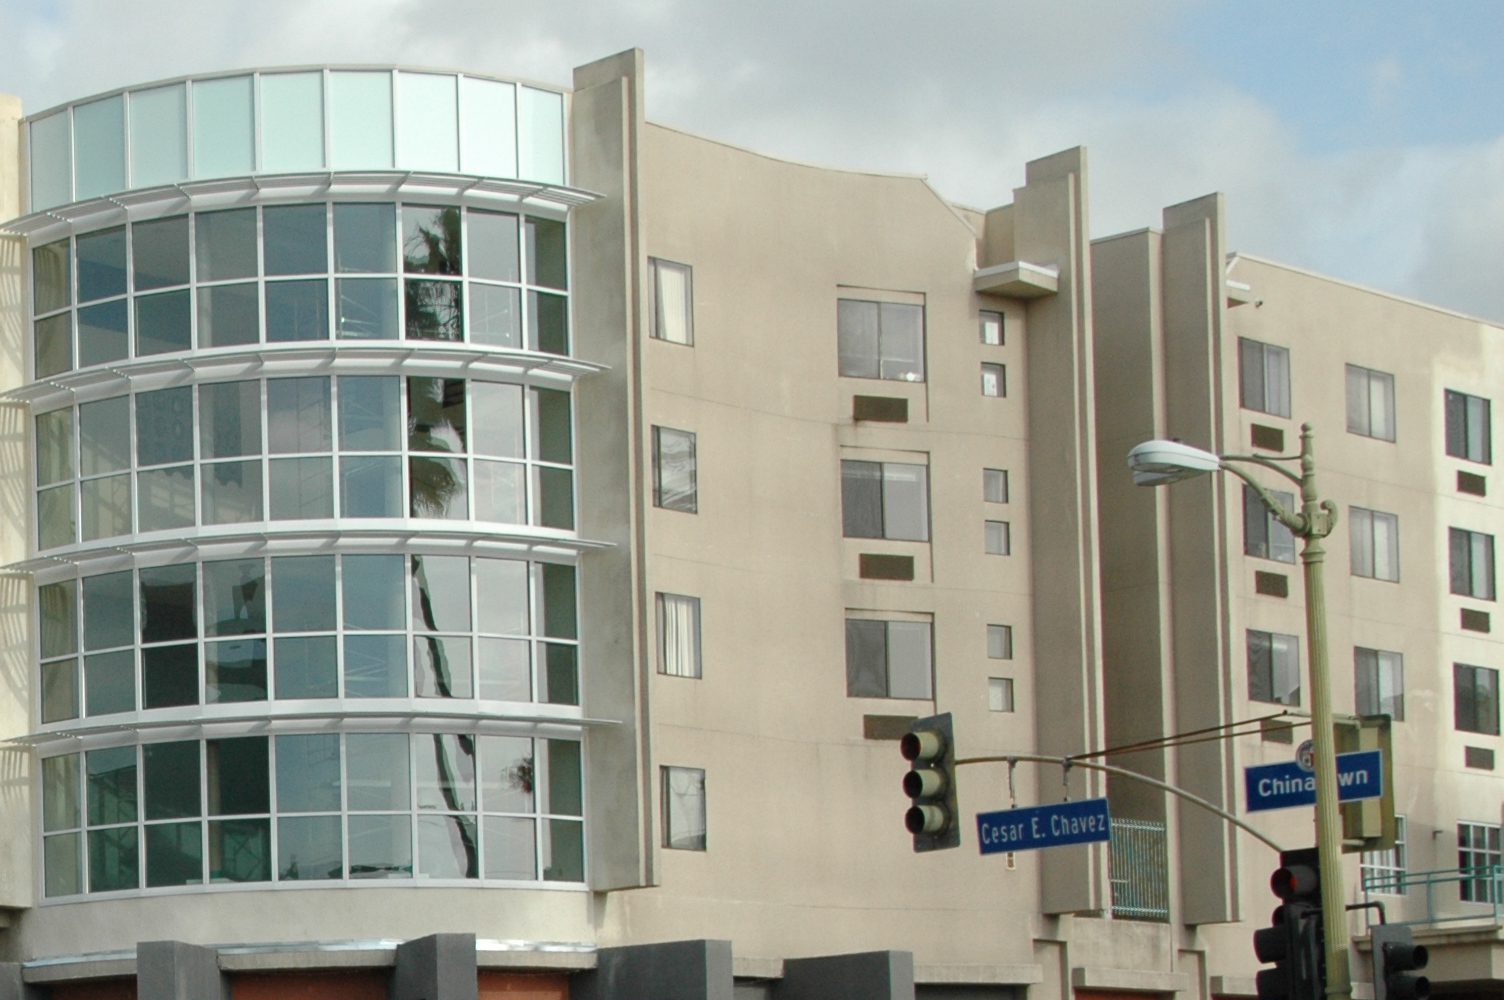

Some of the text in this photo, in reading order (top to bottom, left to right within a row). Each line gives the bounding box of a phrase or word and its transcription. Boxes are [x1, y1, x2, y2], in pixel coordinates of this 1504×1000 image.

[1258, 769, 1368, 797] Chinawn
[981, 814, 1106, 844] Cesar E. Chavez
